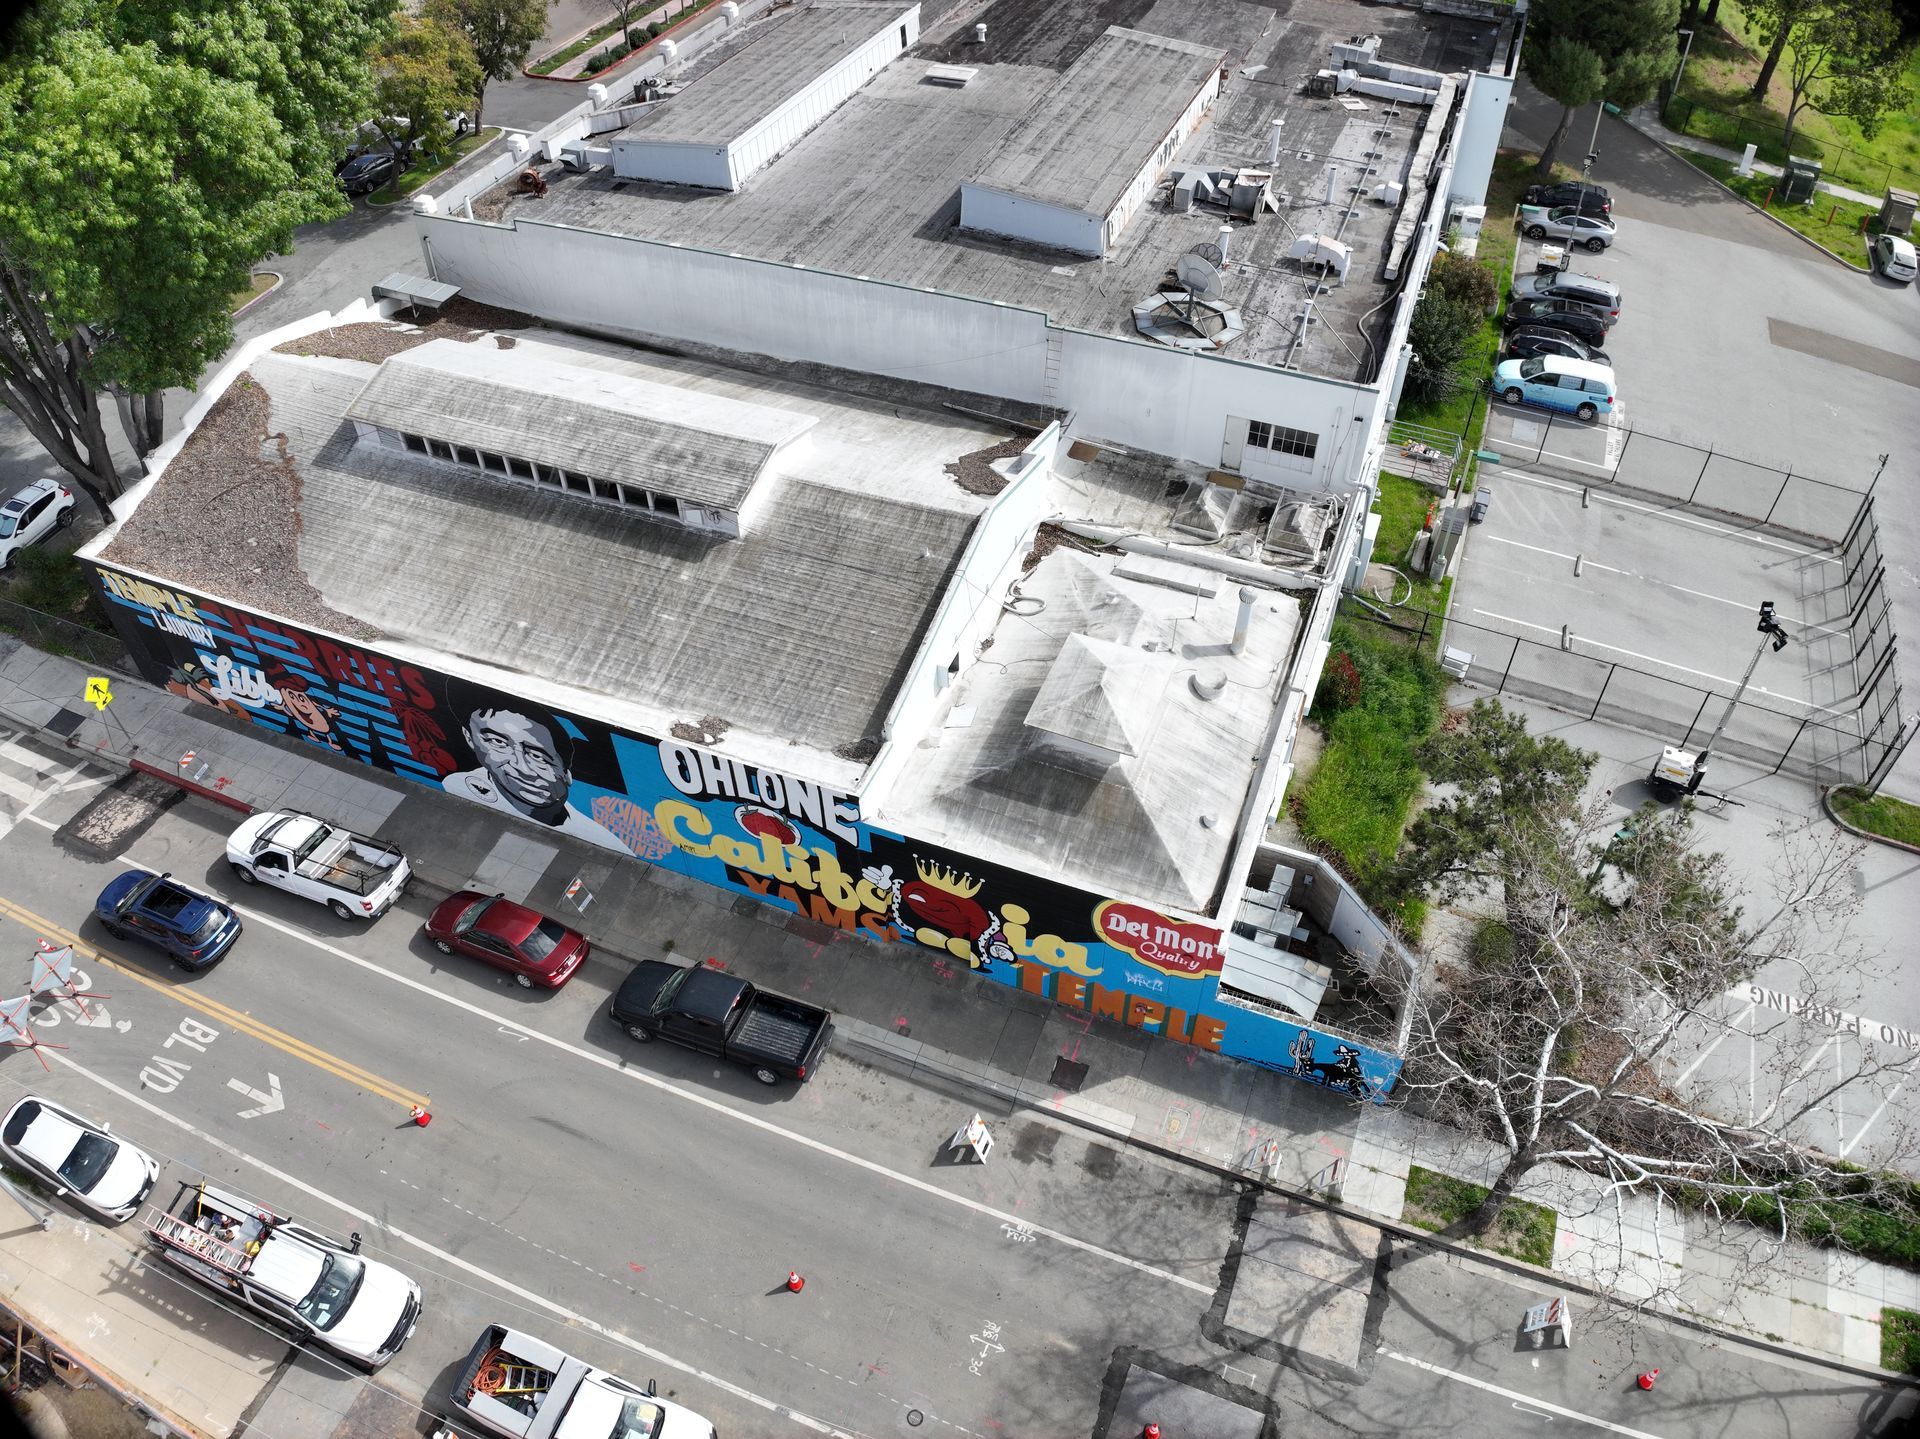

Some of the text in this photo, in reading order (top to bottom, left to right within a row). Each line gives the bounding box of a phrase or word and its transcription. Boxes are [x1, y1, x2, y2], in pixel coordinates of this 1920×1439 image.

[96, 567, 204, 625] TEMPLE
[151, 609, 217, 649] LAUNDRY
[200, 601, 437, 709] CHERRIES
[658, 740, 860, 847] OHLONE
[1107, 913, 1219, 960] Del Mon
[1013, 959, 1226, 1052] TEMPLE
[1750, 986, 1912, 1049] NO PARKING
[139, 1017, 219, 1093] BLVD
